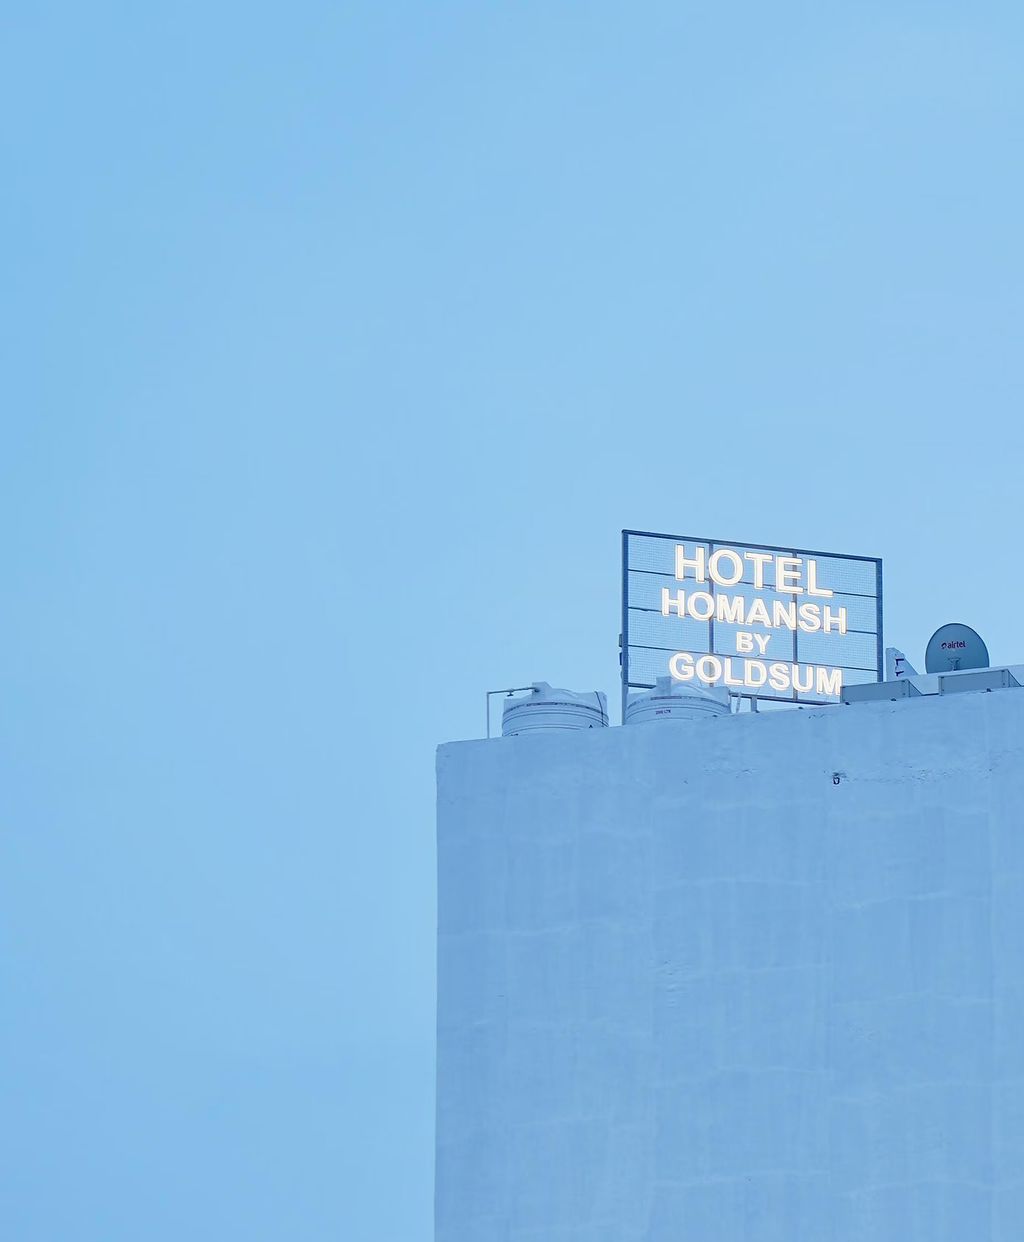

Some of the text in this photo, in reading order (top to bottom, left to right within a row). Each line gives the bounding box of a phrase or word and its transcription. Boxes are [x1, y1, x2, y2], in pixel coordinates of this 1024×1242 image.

[675, 544, 833, 597] HOTEL
[661, 588, 848, 635] HOMANSH
[736, 631, 771, 654] BY
[947, 641, 966, 649] airtel
[669, 652, 843, 695] GOLDSUM
